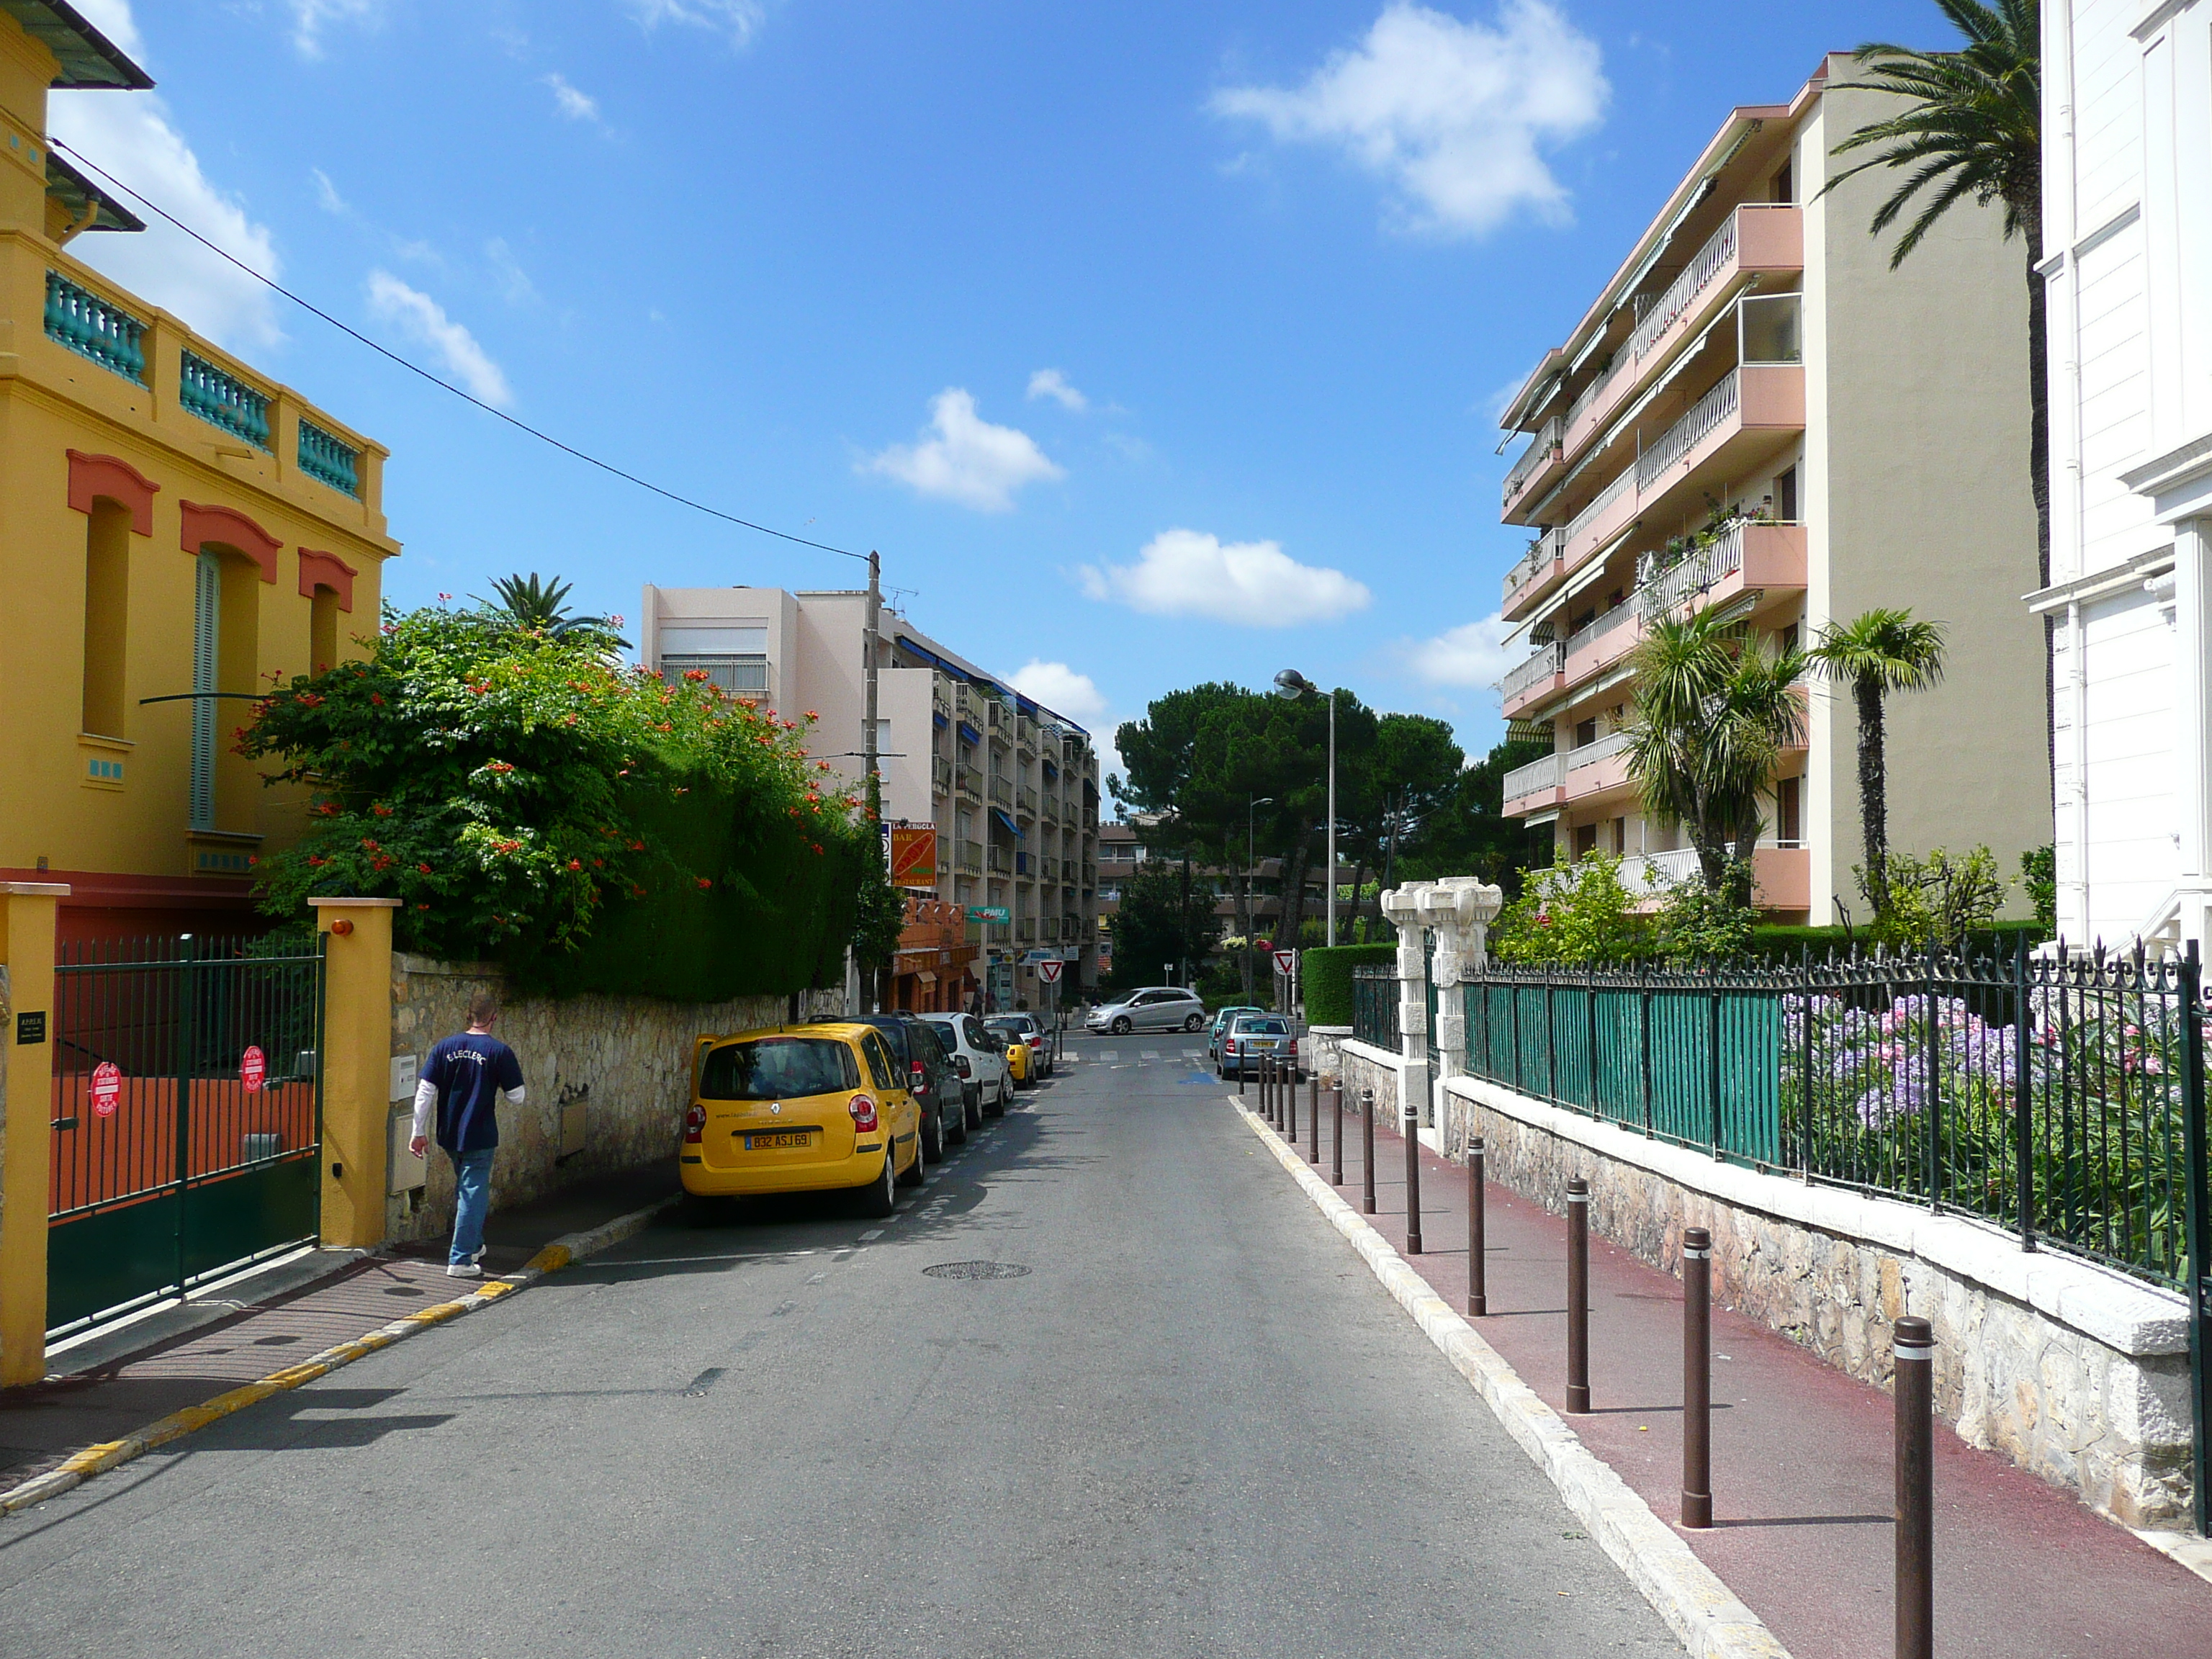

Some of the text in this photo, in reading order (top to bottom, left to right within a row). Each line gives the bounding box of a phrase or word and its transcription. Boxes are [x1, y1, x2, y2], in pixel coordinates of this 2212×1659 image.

[984, 908, 1005, 917] PMU
[453, 1050, 487, 1066] LECLERC
[755, 1134, 807, 1148] 832 ASJ 69
